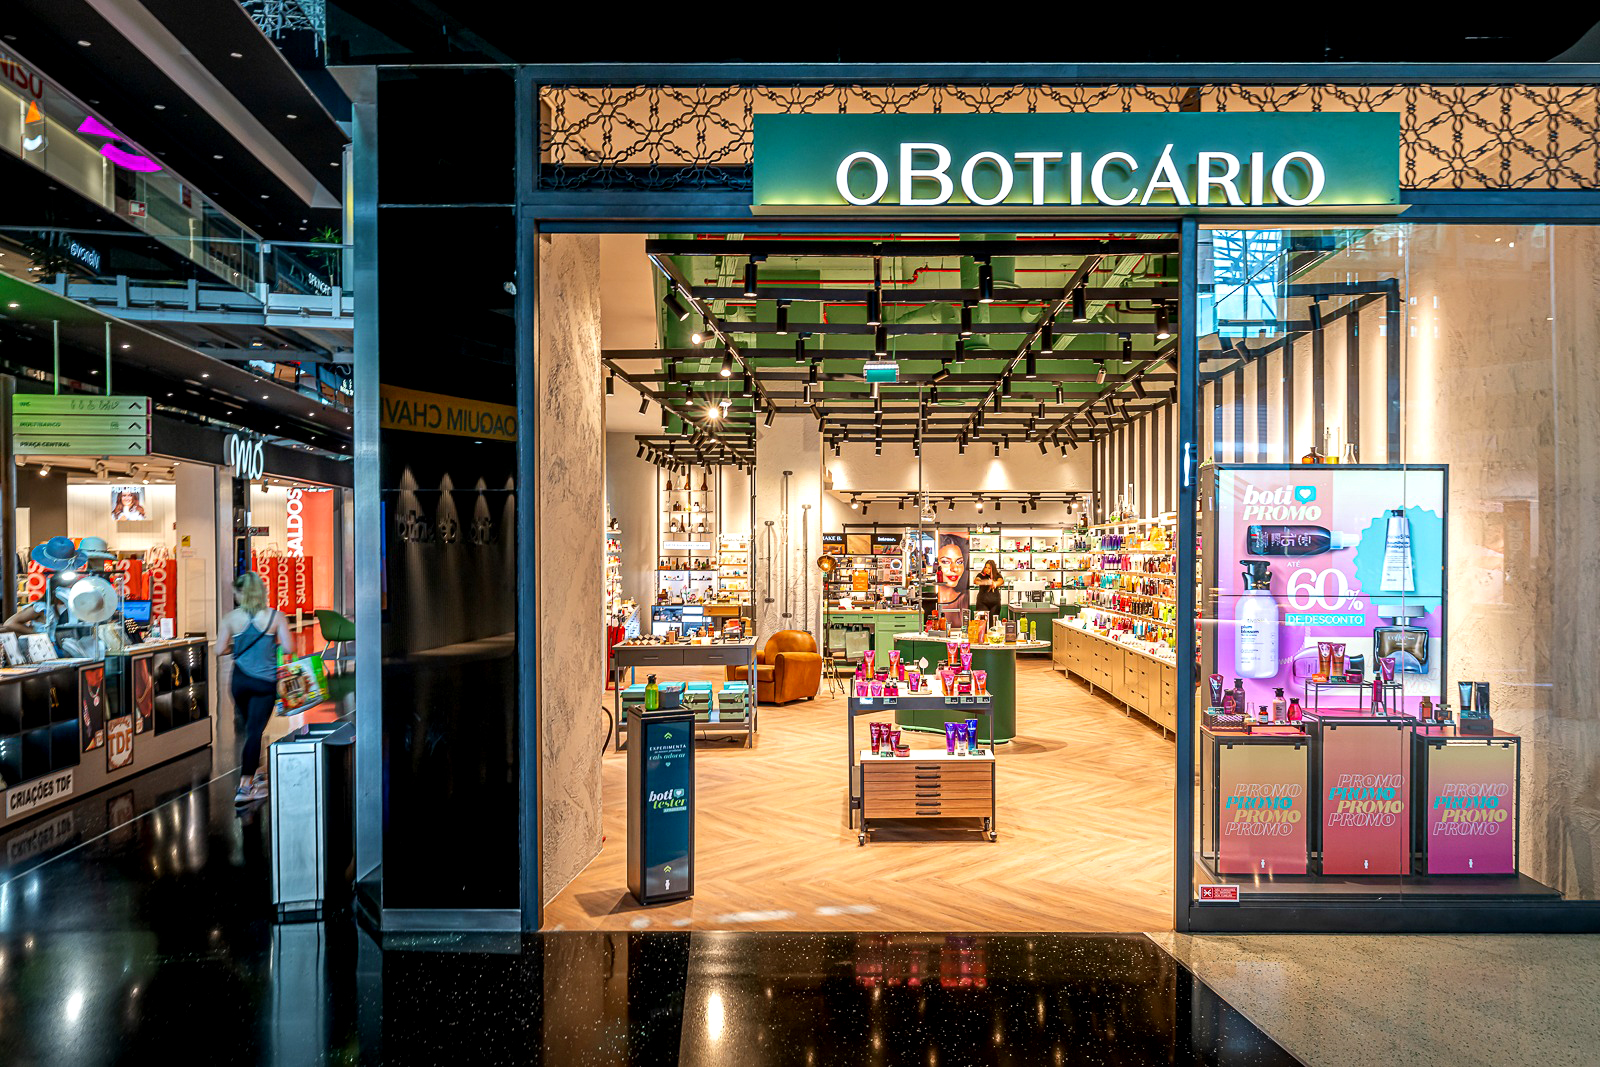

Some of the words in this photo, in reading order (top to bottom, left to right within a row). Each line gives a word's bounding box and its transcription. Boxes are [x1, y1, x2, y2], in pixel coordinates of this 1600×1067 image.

[1243, 485, 1293, 505] boti
[1243, 505, 1322, 521] PROMO
[278, 557, 289, 607] SALDOS
[297, 557, 306, 605] SALDOS
[1287, 568, 1364, 611] 60%
[1288, 615, 1303, 625] DE
[1305, 615, 1363, 625] DESCONTO
[108, 727, 133, 757] TDF
[649, 744, 687, 752] EXPERIMENTA
[1337, 774, 1405, 788] PROMO
[10, 780, 54, 810] CRIAÇÕES
[55, 774, 72, 793] TDF
[648, 789, 674, 802] boti
[1234, 784, 1303, 797] PROMO
[1328, 787, 1397, 800] PROMO
[1441, 783, 1509, 797] PROMO
[653, 799, 687, 810] tester
[1225, 796, 1293, 810] PROMO
[1336, 800, 1405, 813] PROMO
[1433, 796, 1499, 810] PROMO
[1233, 809, 1302, 823] PROMO
[1328, 813, 1396, 826] PROMO
[1441, 809, 1508, 823] PROMO
[1224, 822, 1293, 836] PROMO
[1432, 822, 1500, 836] PROMO
